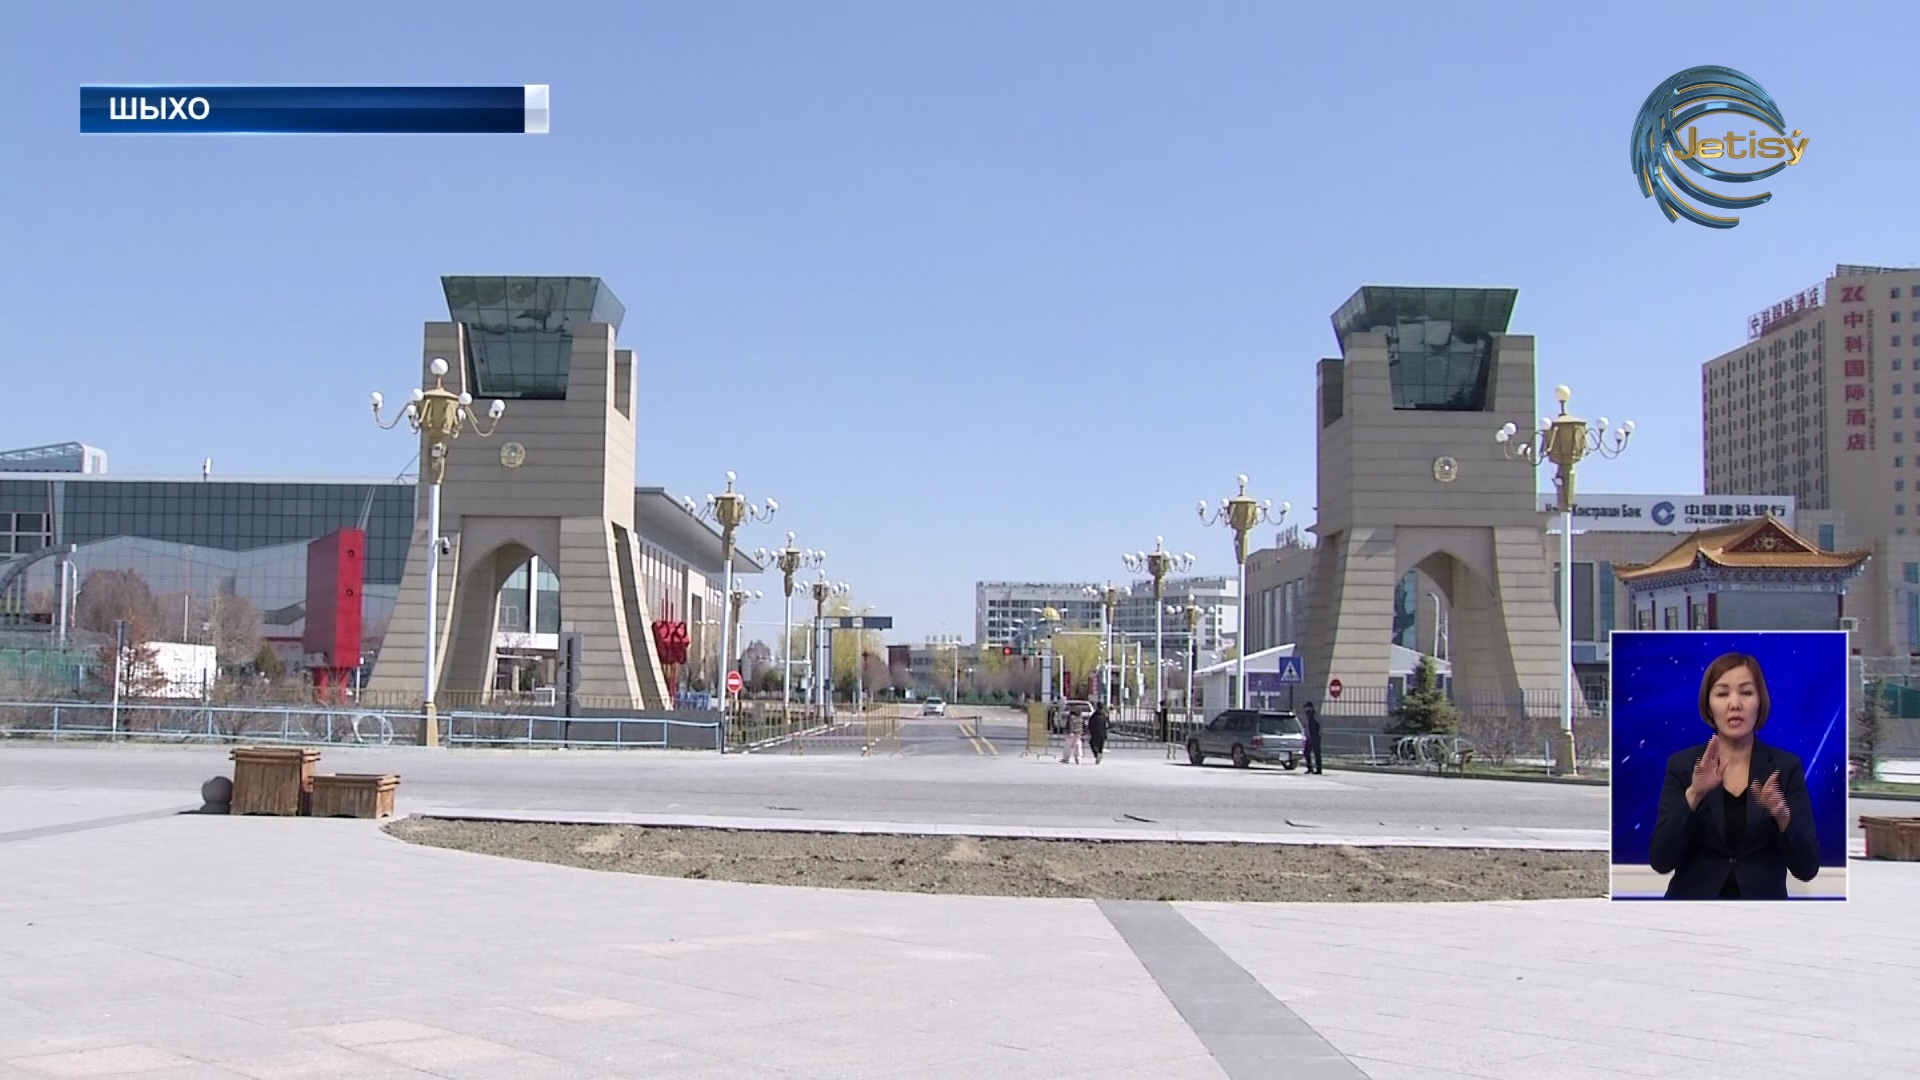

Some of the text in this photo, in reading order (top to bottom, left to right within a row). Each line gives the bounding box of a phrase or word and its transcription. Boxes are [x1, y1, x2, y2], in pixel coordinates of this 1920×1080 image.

[1843, 311, 1867, 451] 中科国际酒店
[1684, 503, 1786, 517] 中国建设银行
